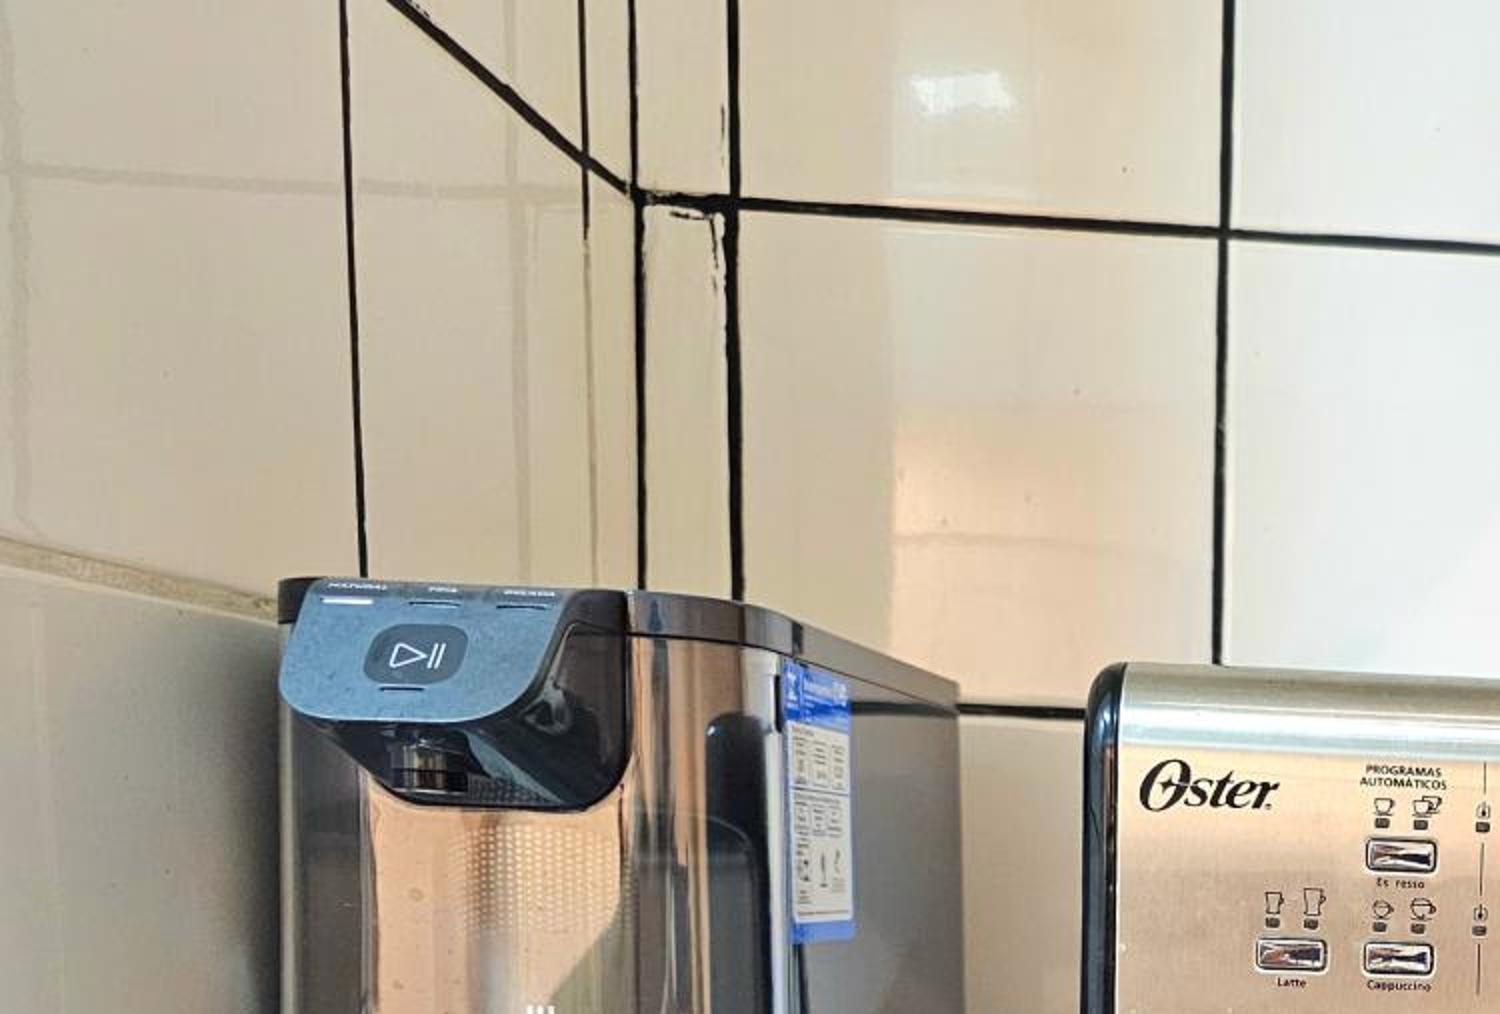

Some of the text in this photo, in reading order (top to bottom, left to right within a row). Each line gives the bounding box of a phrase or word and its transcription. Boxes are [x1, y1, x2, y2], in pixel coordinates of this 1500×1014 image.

[1366, 765, 1442, 778] PROGRAMAS
[1139, 758, 1280, 812] Oster
[1360, 776, 1447, 791] AUTOMÁTICOS
[1376, 877, 1425, 889] Esresso
[1277, 977, 1307, 989] Latte
[1366, 979, 1432, 993] Cappuccino
